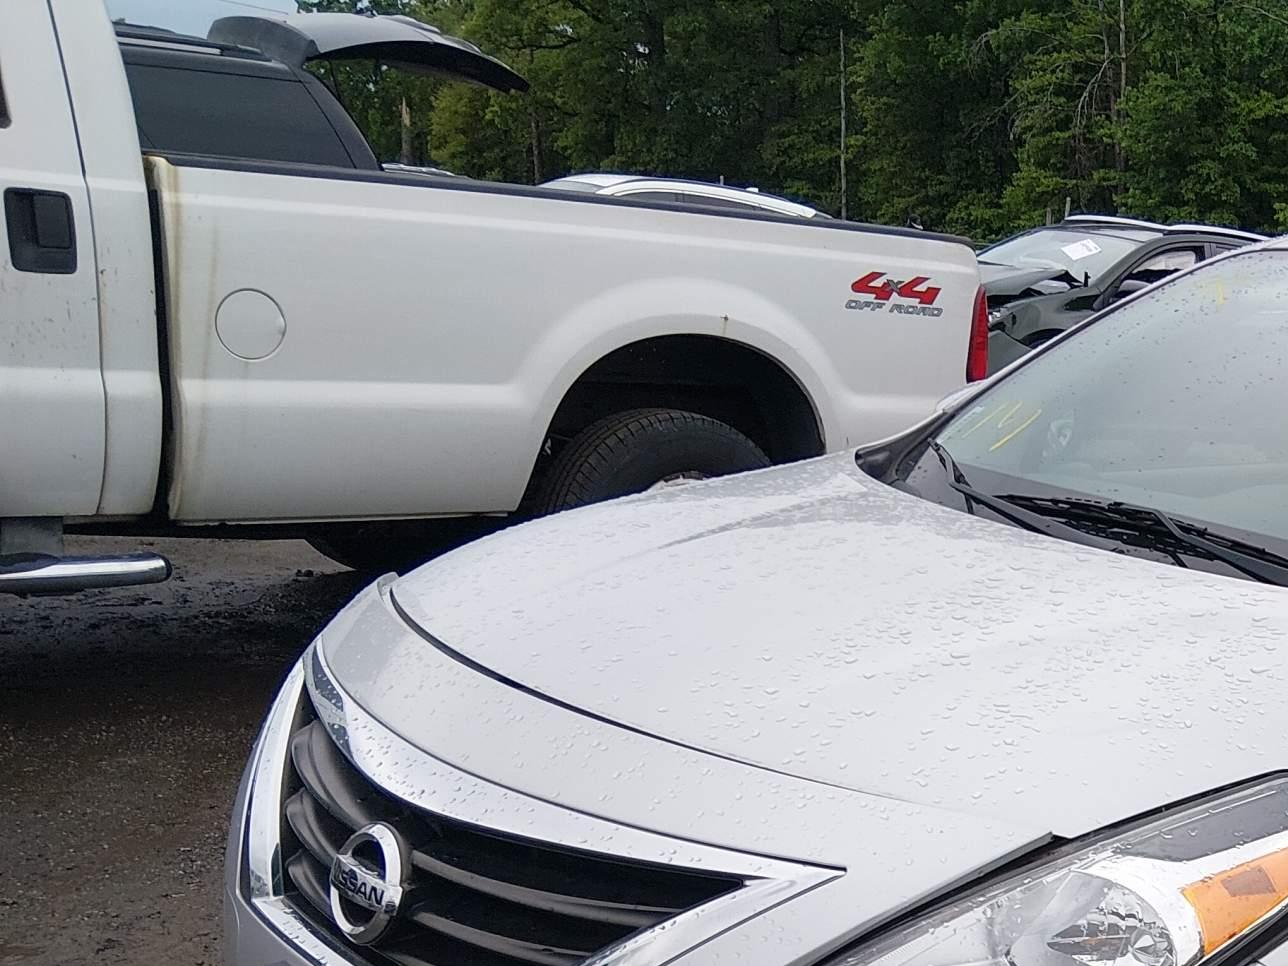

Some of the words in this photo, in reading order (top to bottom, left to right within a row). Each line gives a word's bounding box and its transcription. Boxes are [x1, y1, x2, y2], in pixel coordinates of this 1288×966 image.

[845, 299, 886, 311] OFF
[889, 303, 943, 317] ROAD
[334, 859, 385, 906] SSAN
